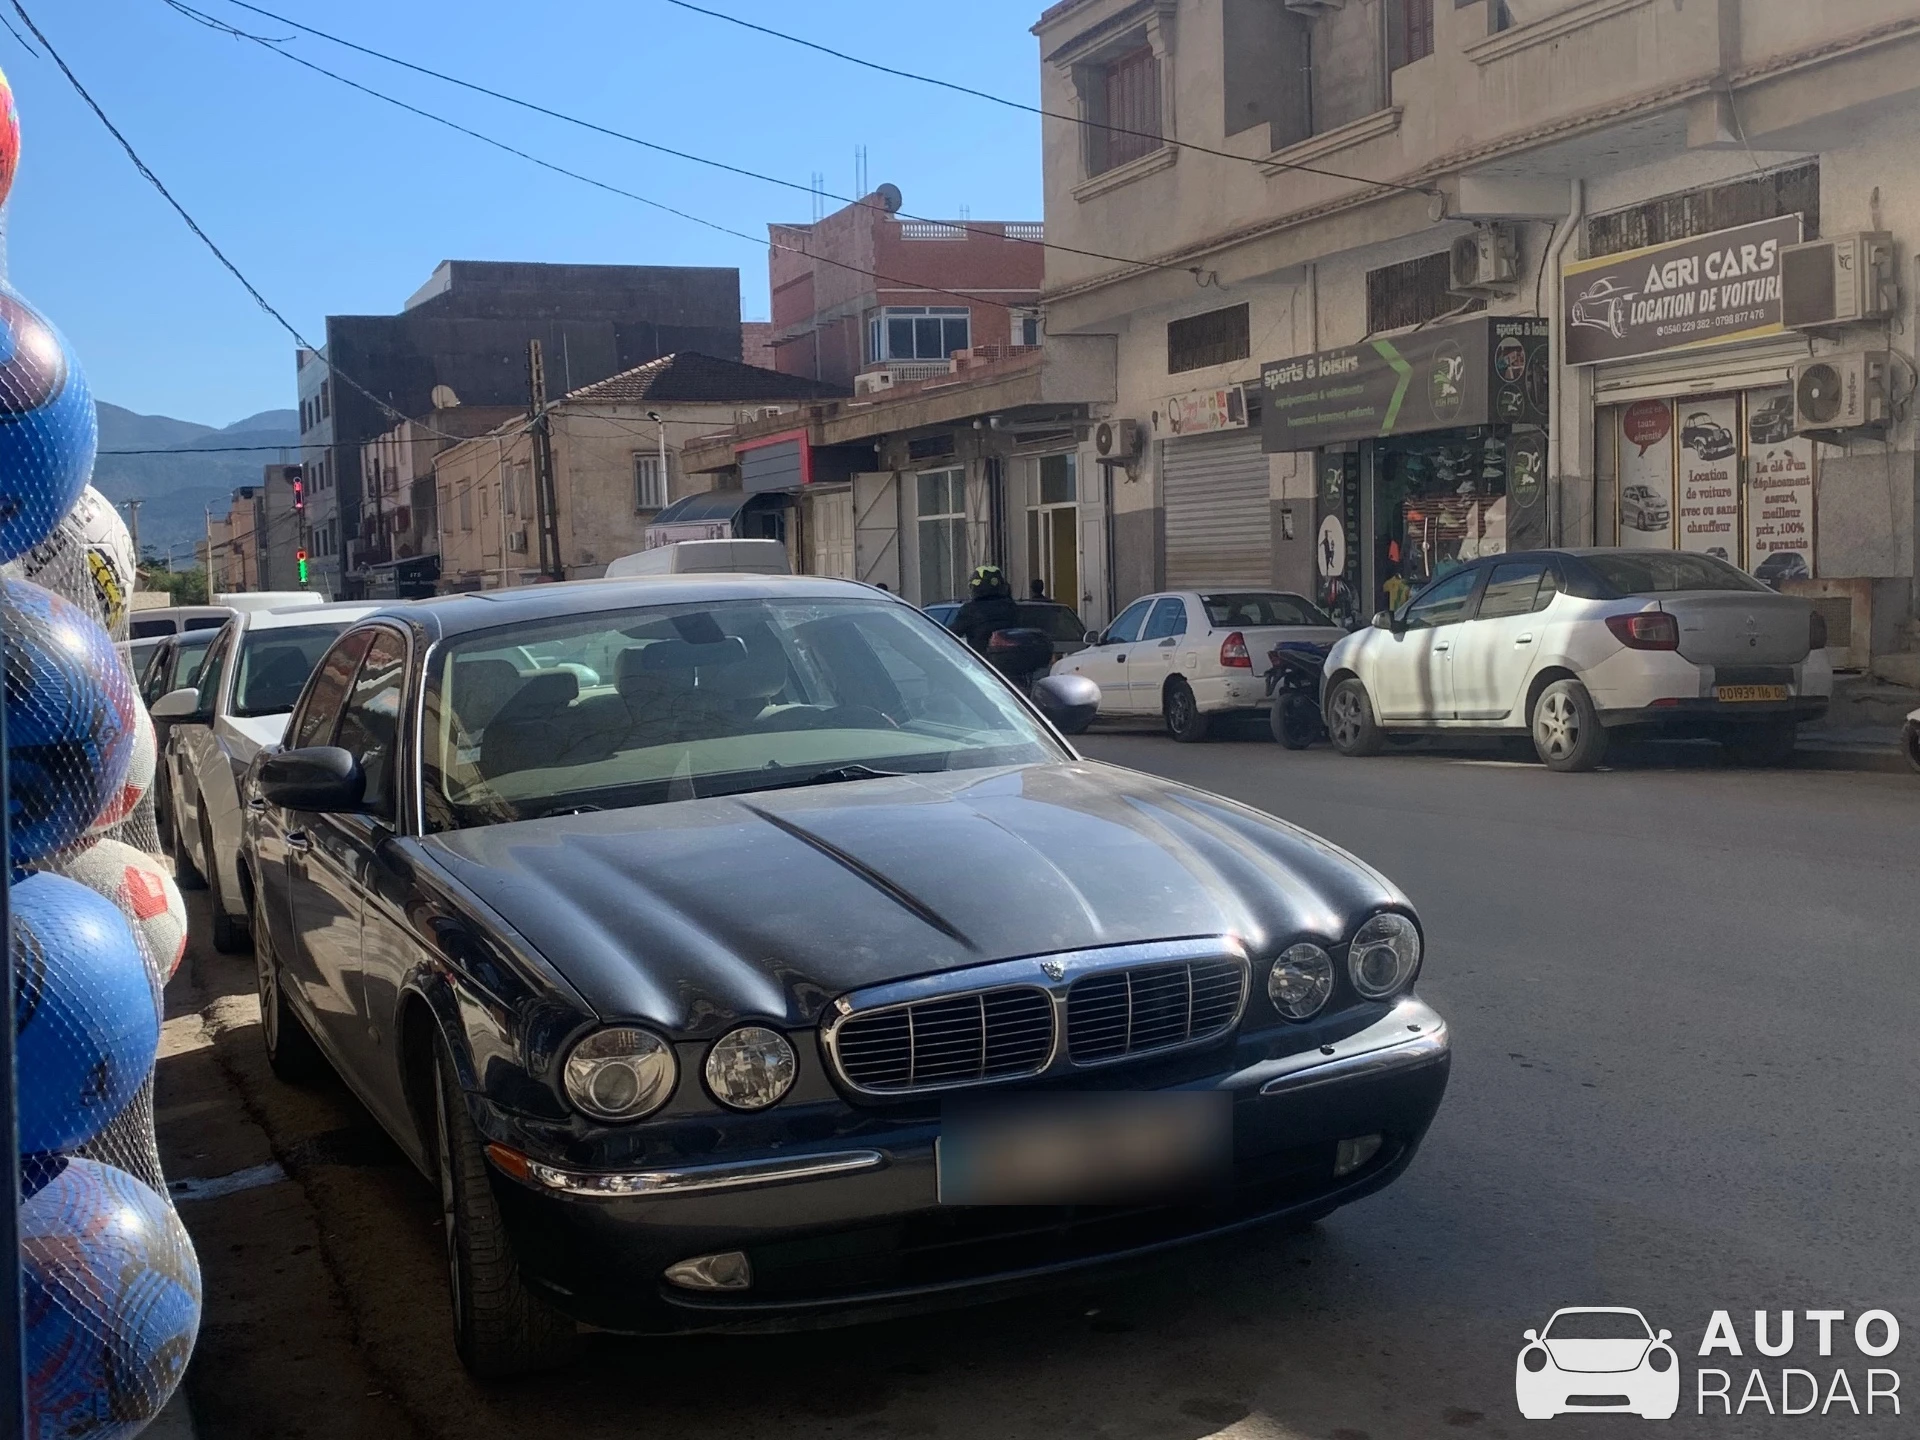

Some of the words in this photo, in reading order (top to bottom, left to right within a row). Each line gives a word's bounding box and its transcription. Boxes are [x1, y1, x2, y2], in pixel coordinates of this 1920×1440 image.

[1643, 256, 1699, 295] AGRI
[1705, 238, 1778, 281] CARS
[1630, 291, 1695, 326] LOCATION
[1698, 287, 1717, 314] DE
[1496, 322, 1522, 338] sports
[1523, 322, 1531, 336] &
[1264, 362, 1304, 390] sports
[1306, 359, 1316, 379] &
[1319, 350, 1358, 377] loisirs
[1756, 462, 1768, 473] La
[1770, 460, 1784, 472] clé
[1786, 458, 1806, 471] d'un
[1689, 468, 1728, 482] Location
[1753, 476, 1811, 491] déplacement
[1686, 487, 1697, 499] de
[1699, 486, 1732, 499] voiture
[1681, 507, 1701, 517] avec
[1702, 506, 1714, 515] ou
[1716, 505, 1737, 515] sans
[1762, 507, 1801, 519] meilleur
[1687, 520, 1731, 533] chauffeur
[1756, 523, 1774, 537] prix
[1756, 538, 1767, 550] de
[1769, 538, 1808, 552] garantie
